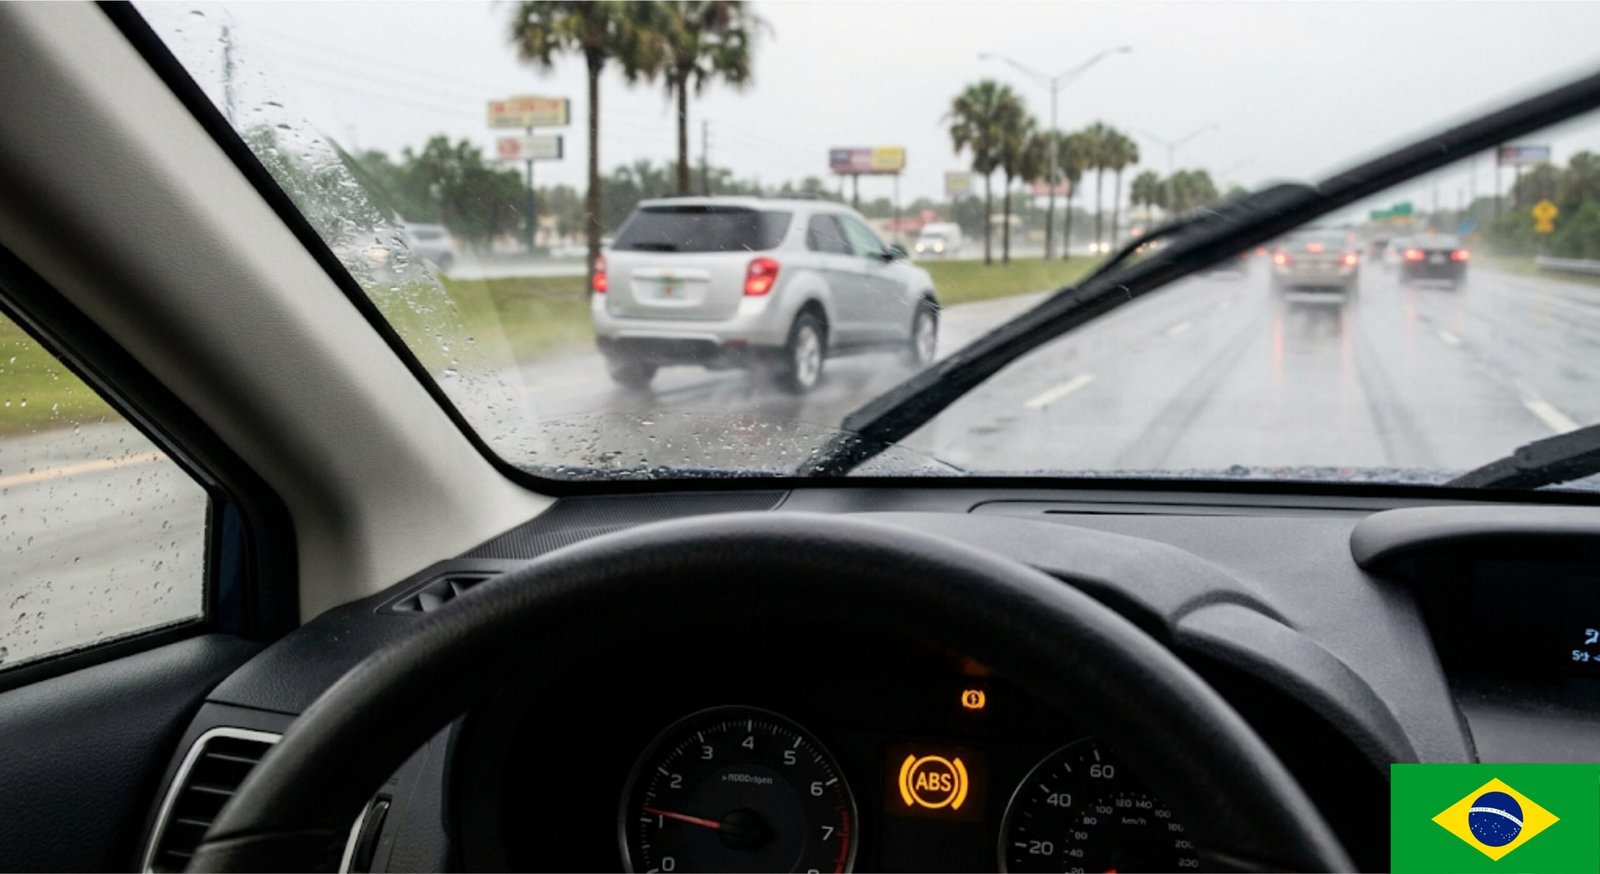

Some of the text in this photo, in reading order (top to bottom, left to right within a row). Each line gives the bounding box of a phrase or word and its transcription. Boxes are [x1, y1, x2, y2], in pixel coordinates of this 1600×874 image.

[741, 735, 755, 750] 4
[701, 745, 714, 760] 3
[784, 750, 797, 765] 5
[1090, 764, 1116, 780] 60
[670, 773, 683, 789] 2
[810, 781, 824, 797] 6
[916, 772, 952, 791] ABS
[1046, 793, 1072, 808] 40
[821, 825, 834, 841] 7
[1029, 840, 1055, 856] 20
[662, 857, 676, 873] 0
